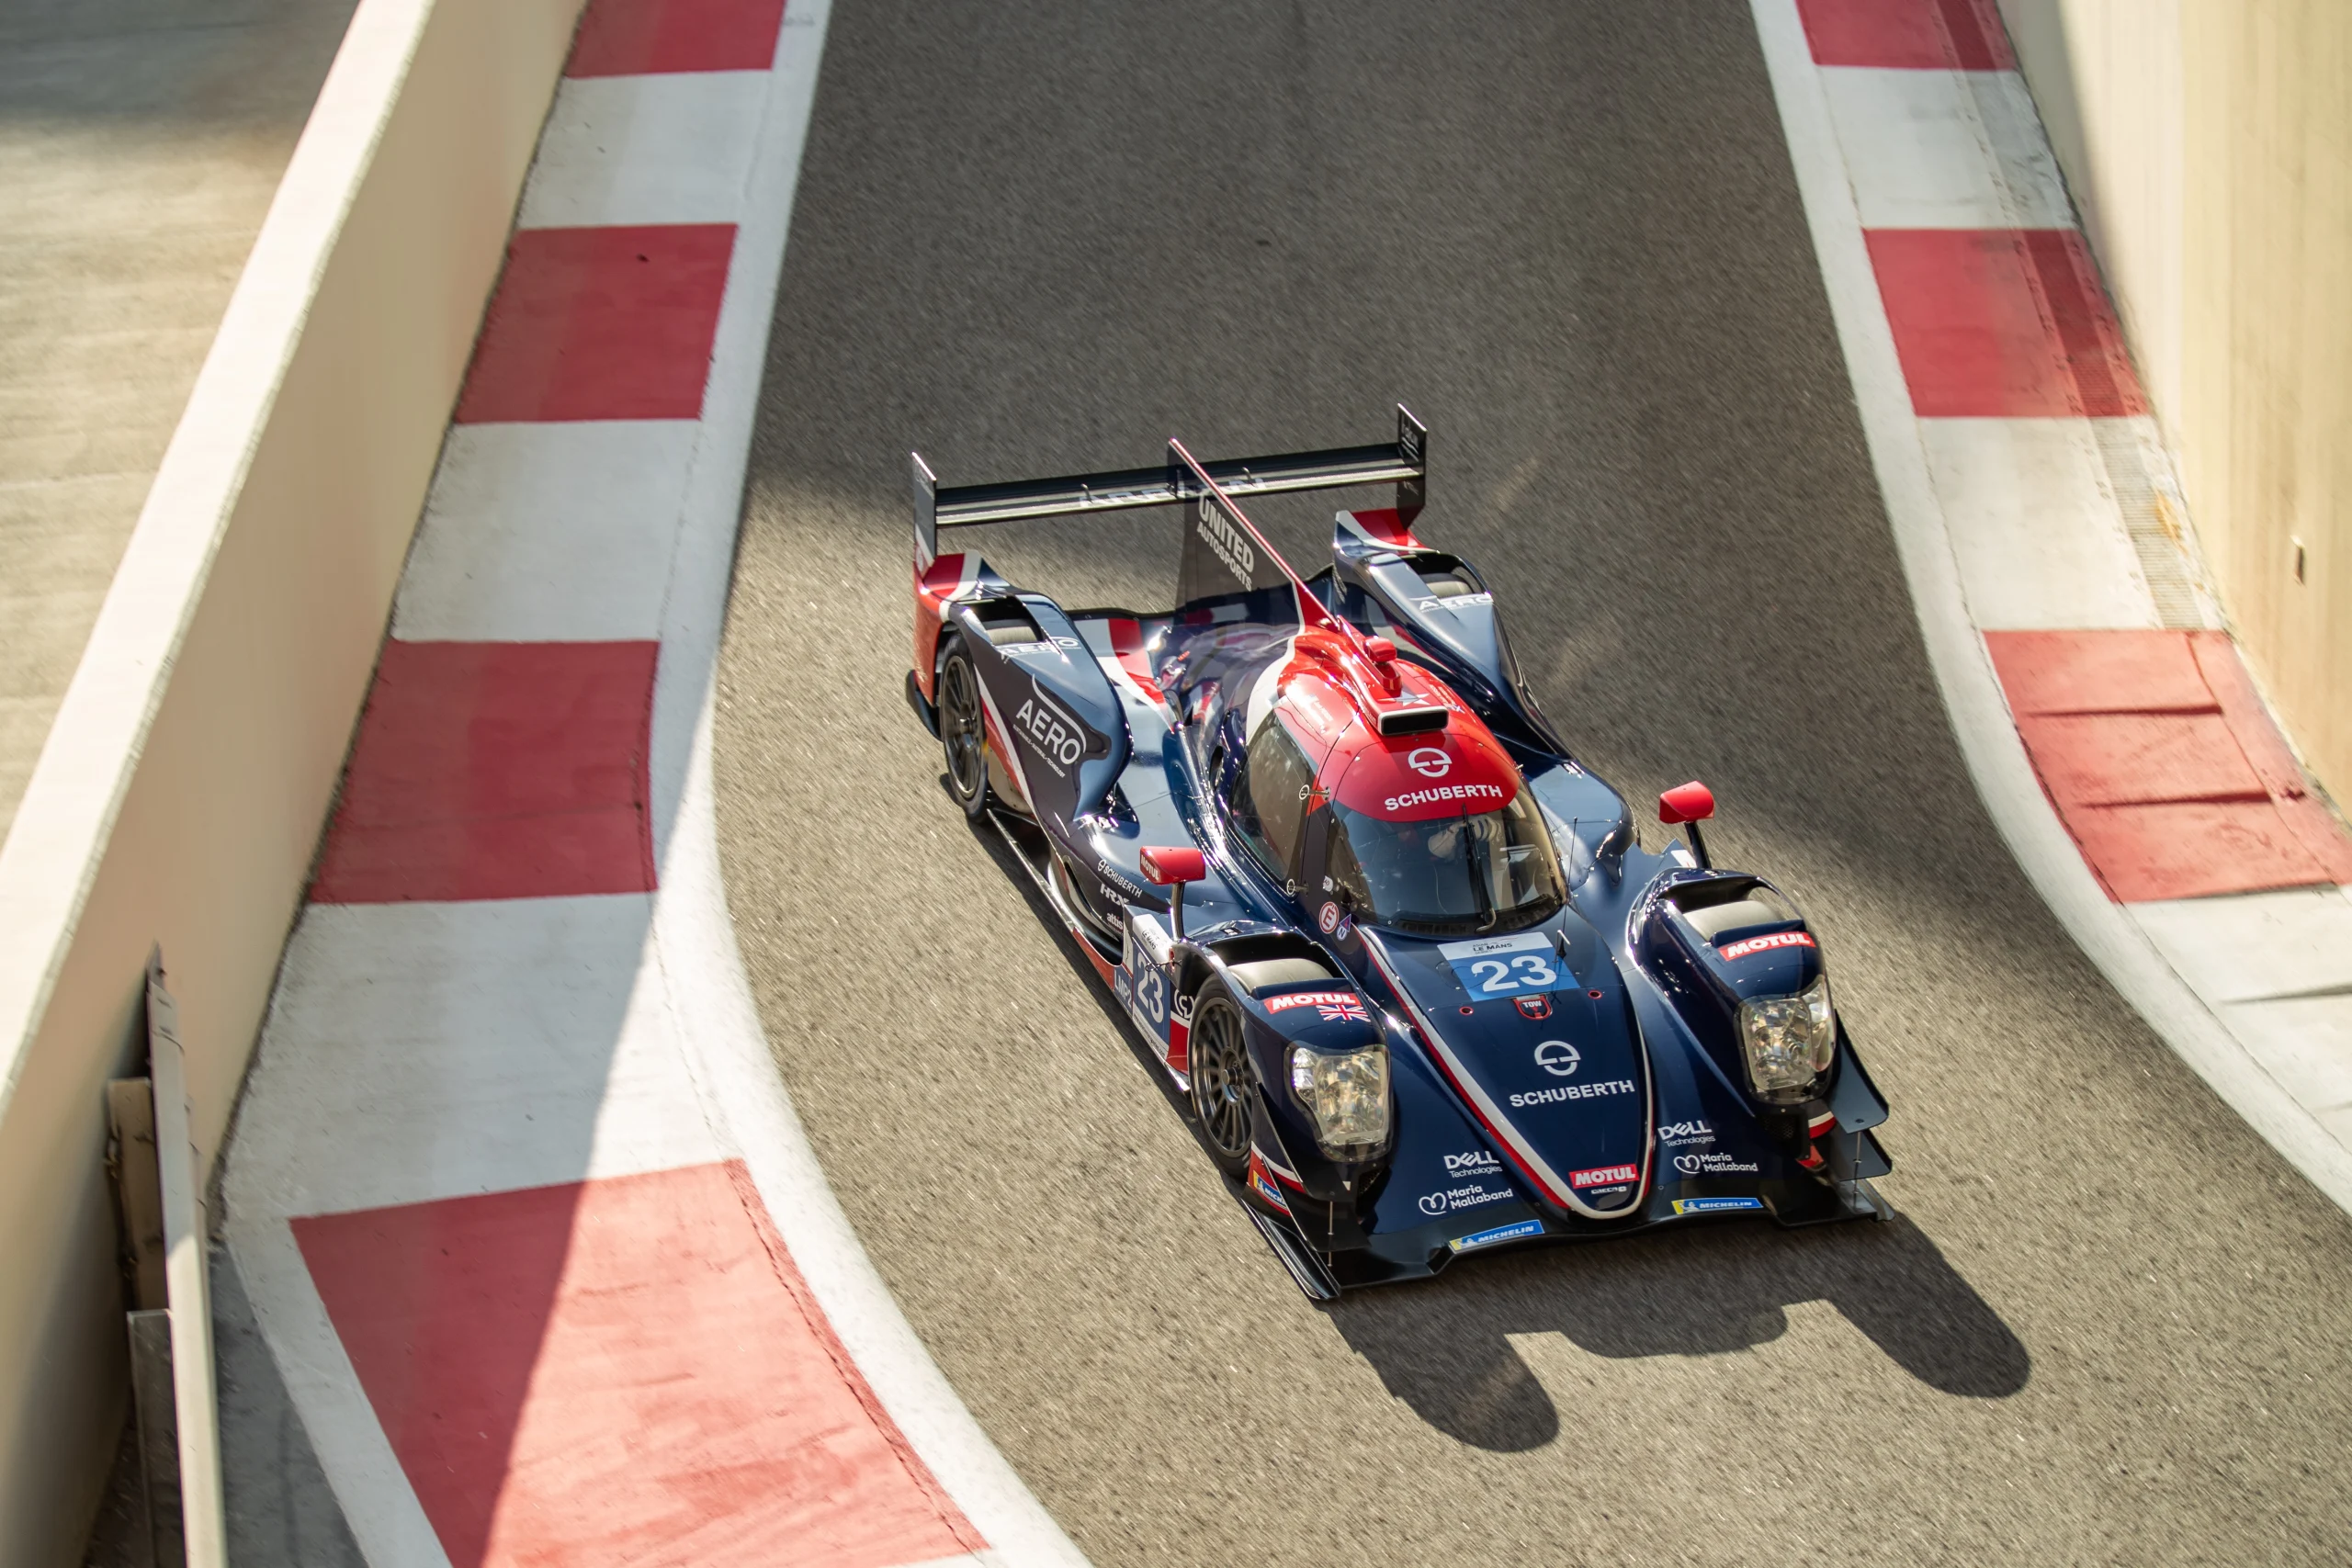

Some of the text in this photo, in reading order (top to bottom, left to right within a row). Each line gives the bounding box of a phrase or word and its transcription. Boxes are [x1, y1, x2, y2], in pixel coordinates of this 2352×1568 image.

[1199, 490, 1254, 573] UNITED
[1197, 521, 1253, 592] AUTOSPORTS
[1015, 698, 1081, 765] AERO
[1384, 784, 1503, 811] SCHUBERTH
[1140, 854, 1160, 882] MOTUL
[1102, 864, 1143, 898] SCHUBERTH
[1727, 933, 1811, 958] MOTUL
[1471, 955, 1557, 992] 23
[1114, 969, 1133, 1008] LMP2
[1136, 952, 1164, 1023] 23
[1272, 994, 1357, 1011] MOTUL
[1522, 1000, 1543, 1009] TOW
[1509, 1079, 1635, 1107] SCHUBERTH
[1657, 1120, 1713, 1140] DELL
[1666, 1134, 1716, 1147] Technologies
[1443, 1151, 1500, 1169] DELL
[1700, 1152, 1733, 1163] Maria
[1703, 1162, 1758, 1172] Mallaband
[1449, 1166, 1503, 1179] Technologies
[1575, 1167, 1636, 1186] MOTUL
[1446, 1184, 1484, 1199] Maria
[1450, 1188, 1513, 1210] Mallaband
[1700, 1201, 1753, 1209] MICHELIN
[1477, 1224, 1534, 1243] MICHELIN
